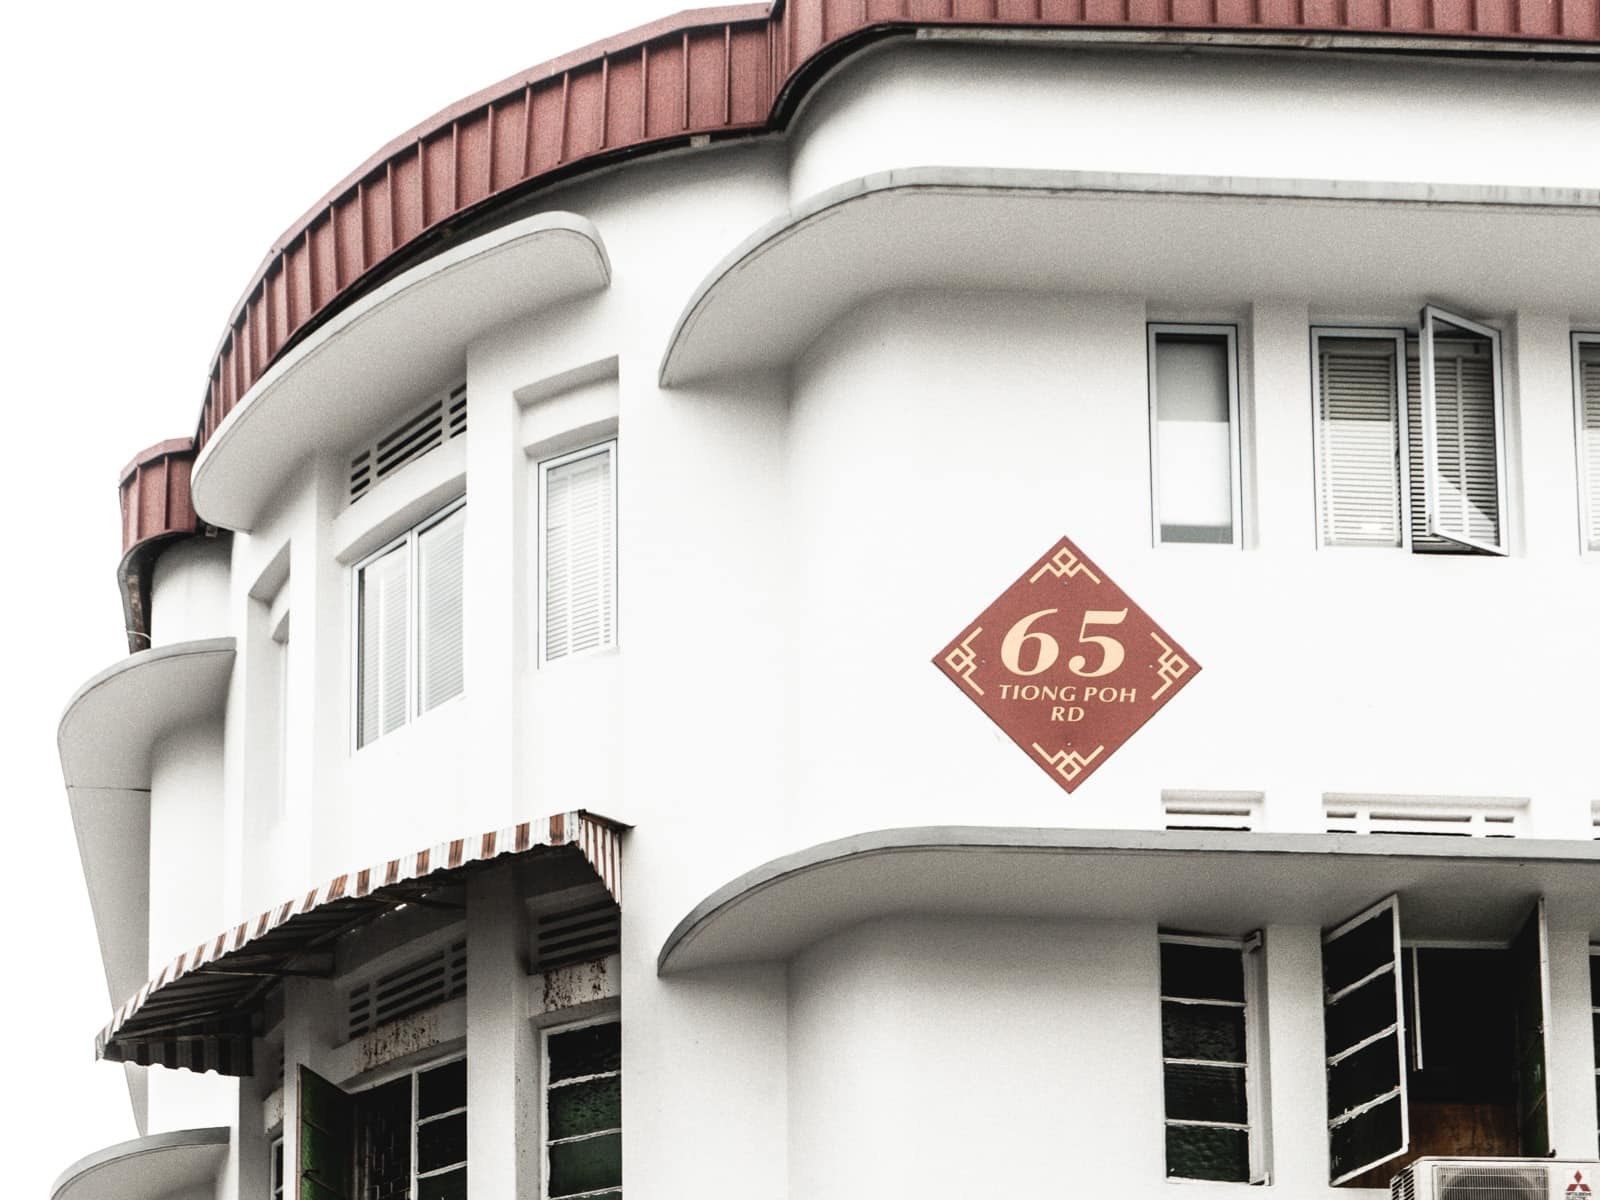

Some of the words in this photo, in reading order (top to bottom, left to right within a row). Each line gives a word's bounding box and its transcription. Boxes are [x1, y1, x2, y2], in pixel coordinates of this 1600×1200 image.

[1000, 608, 1128, 678] 65
[999, 684, 1077, 702] TIONG
[1083, 686, 1137, 703] POH
[1051, 706, 1085, 722] RD
